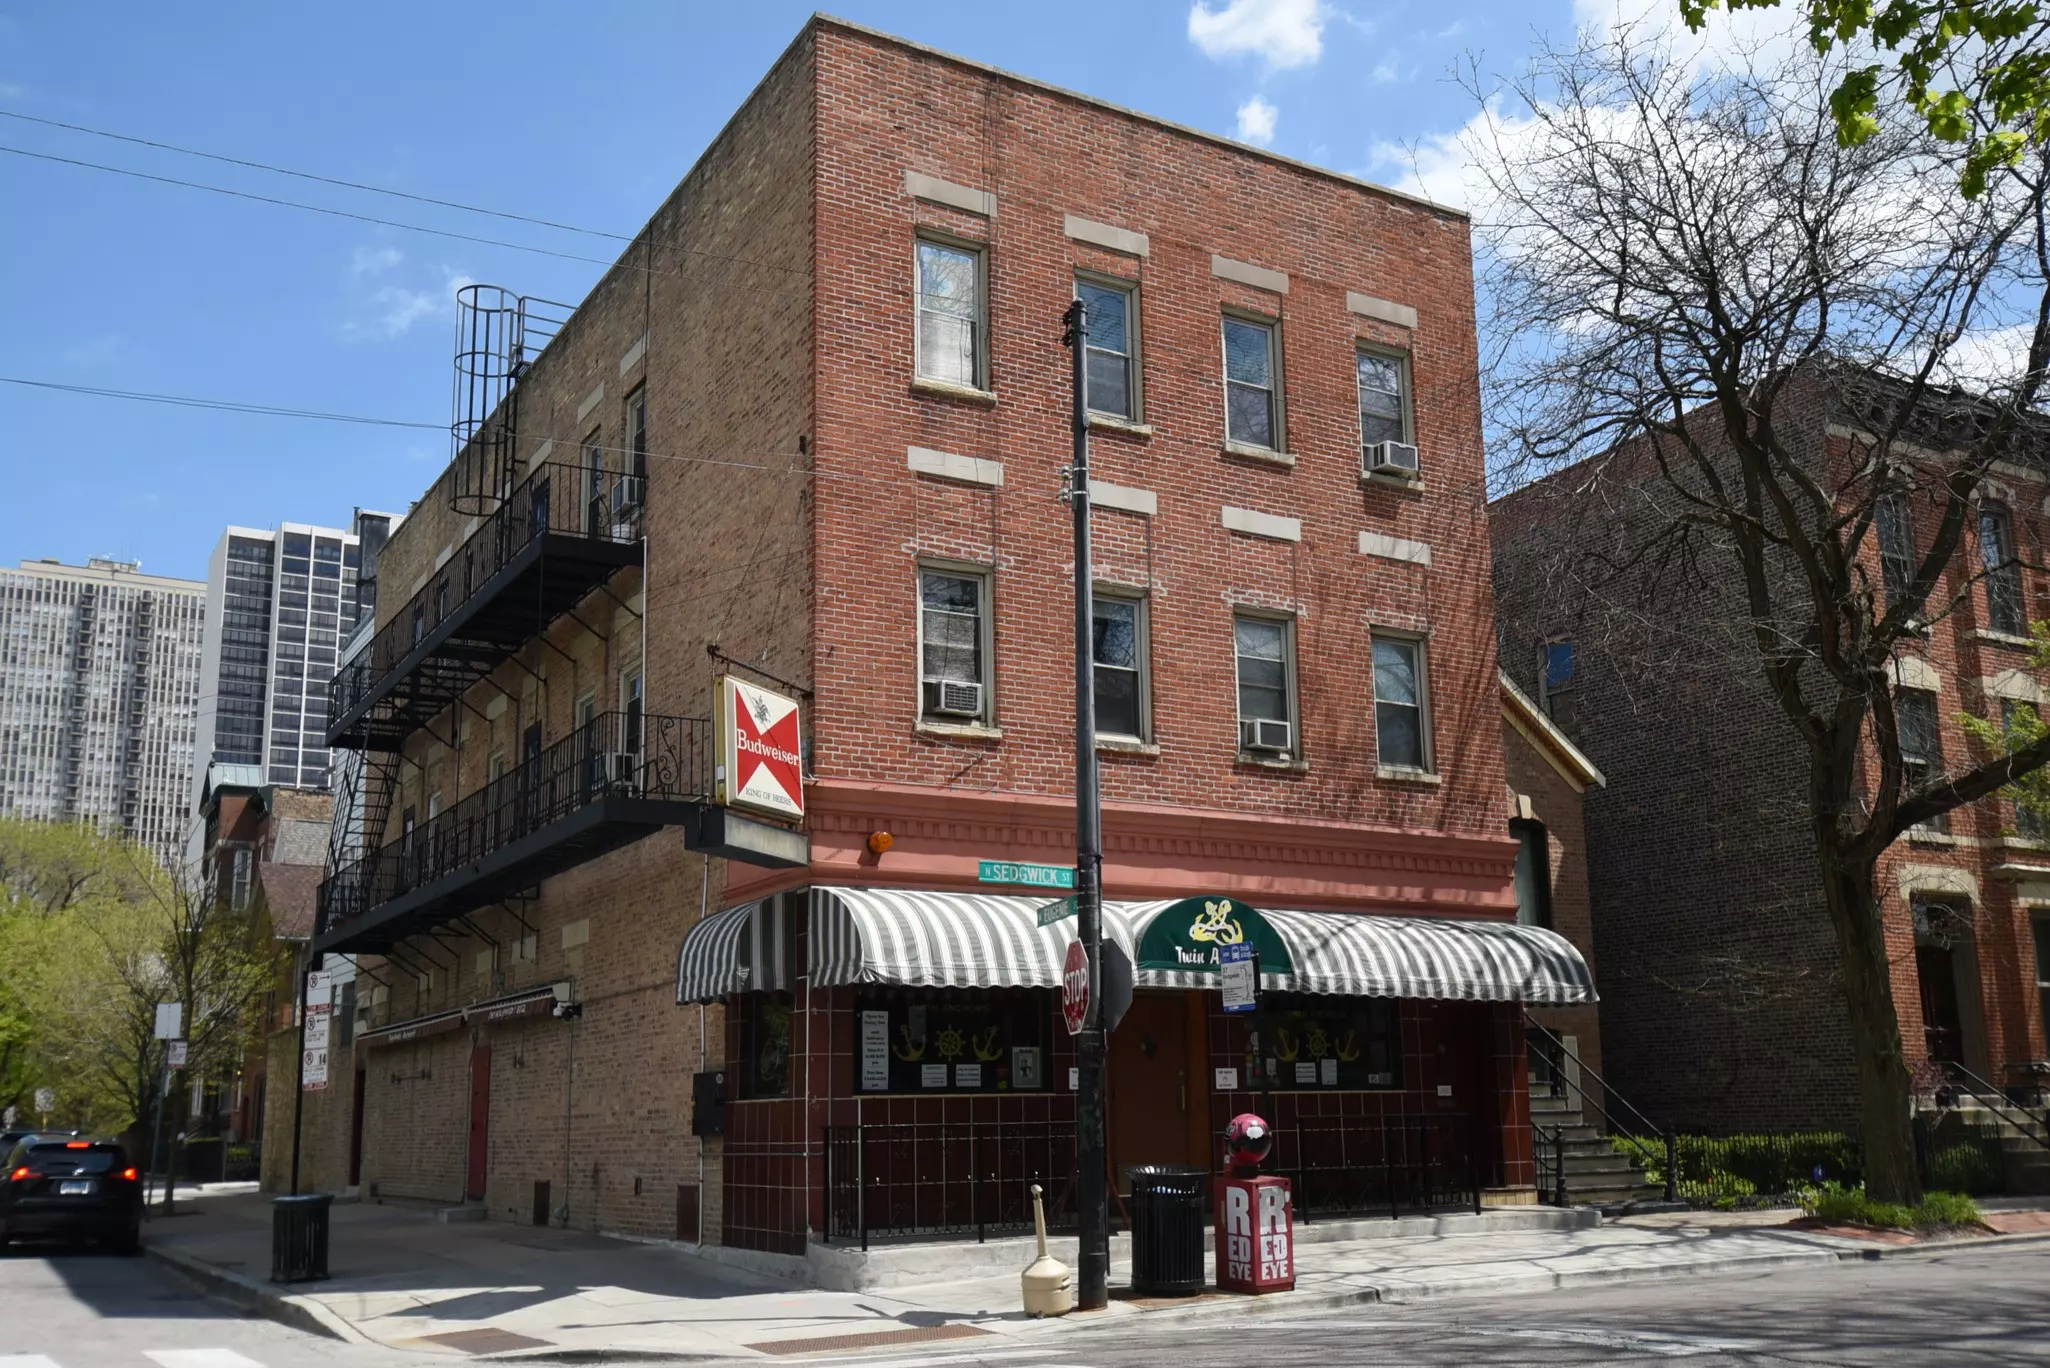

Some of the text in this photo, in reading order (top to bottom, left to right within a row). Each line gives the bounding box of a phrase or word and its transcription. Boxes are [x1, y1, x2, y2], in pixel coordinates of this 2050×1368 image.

[737, 728, 799, 766] Budweiser
[745, 787, 792, 806] KING OF BEERS
[985, 864, 1071, 884] N SEDGWICK ST
[1175, 945, 1205, 964] Twin
[1064, 967, 1087, 1006] STOP
[319, 1053, 326, 1065] 14
[1226, 1186, 1251, 1236] R
[1227, 1234, 1252, 1263] ED
[1260, 1234, 1288, 1263] ED
[1228, 1263, 1252, 1281] EYE
[1261, 1260, 1289, 1281] EYE
